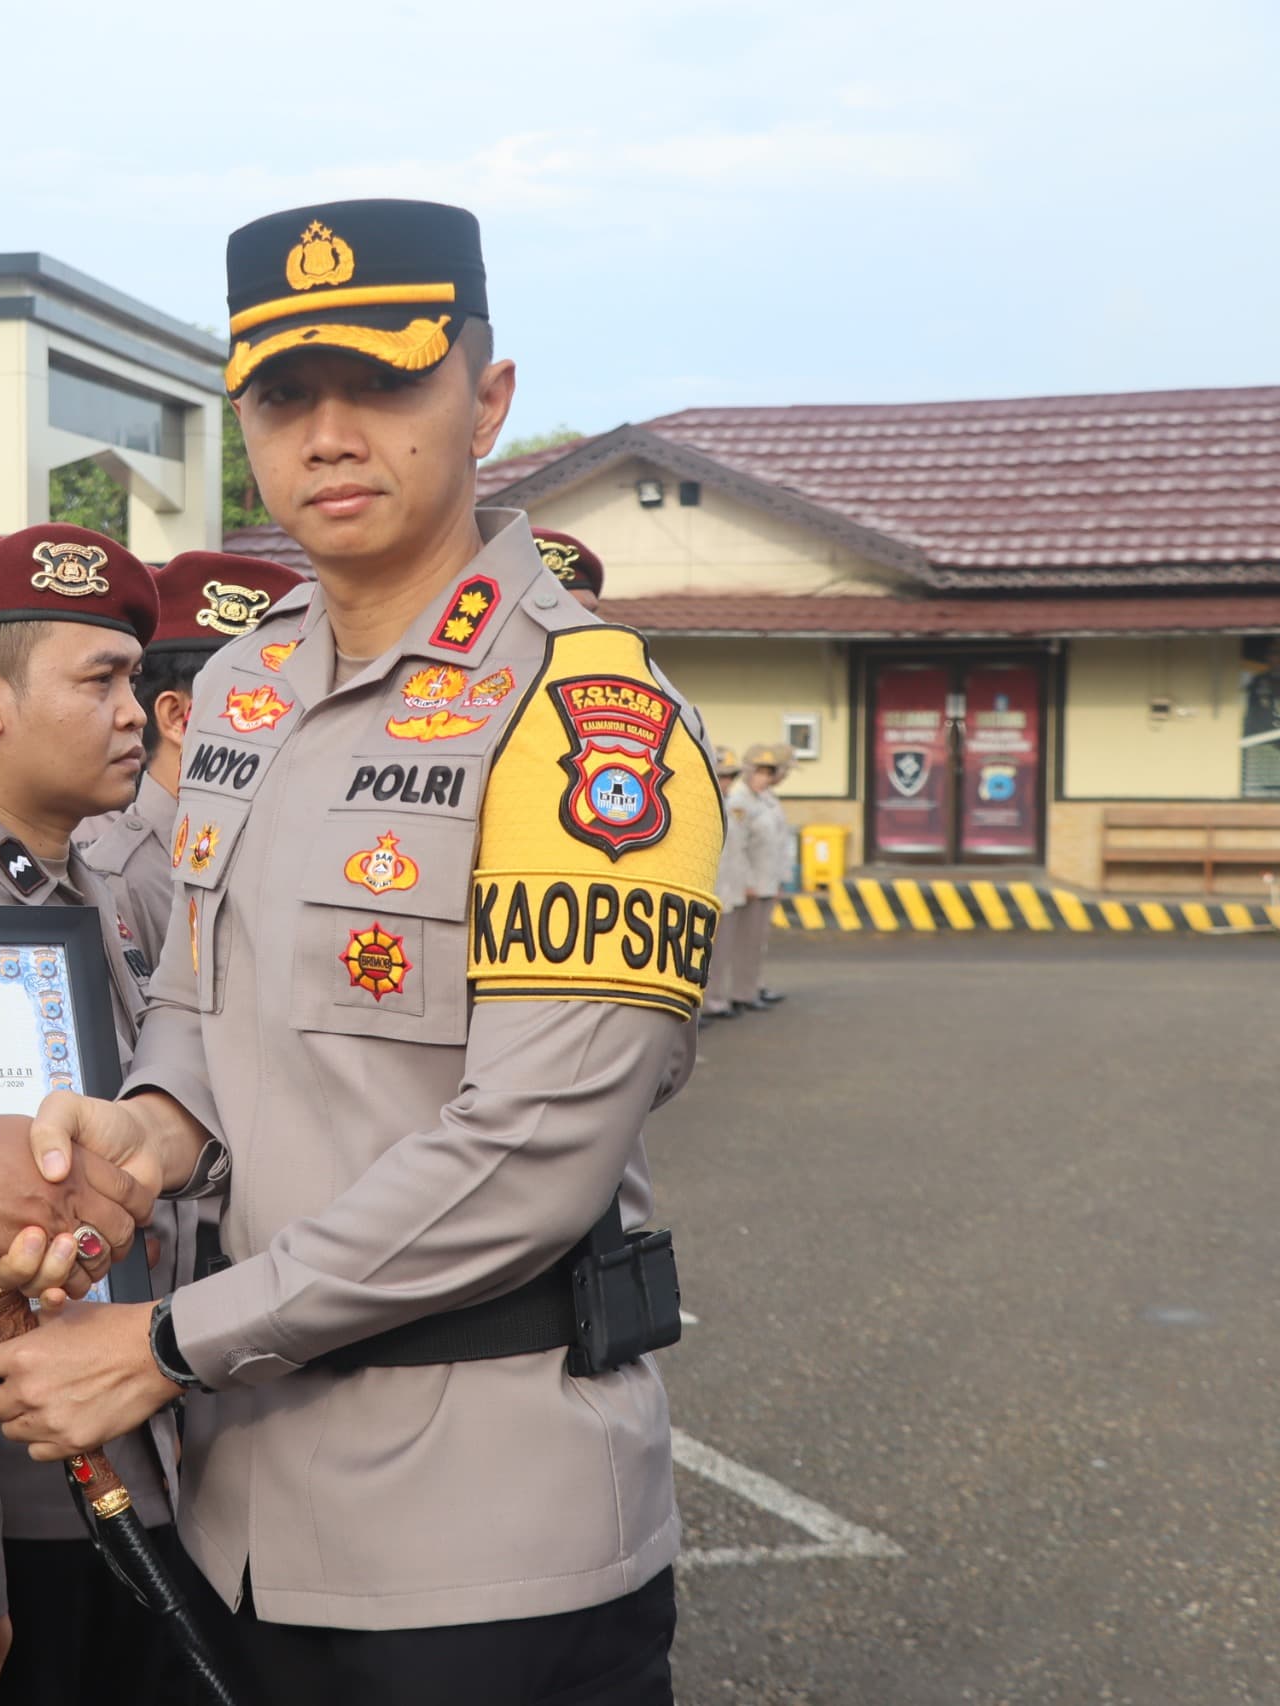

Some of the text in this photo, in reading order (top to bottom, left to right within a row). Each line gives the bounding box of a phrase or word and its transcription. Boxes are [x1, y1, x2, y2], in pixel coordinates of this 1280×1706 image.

[571, 686, 664, 714] POLRES
[573, 697, 663, 722] TABALONG
[187, 743, 261, 790] MOYO
[345, 763, 466, 808] POLRI
